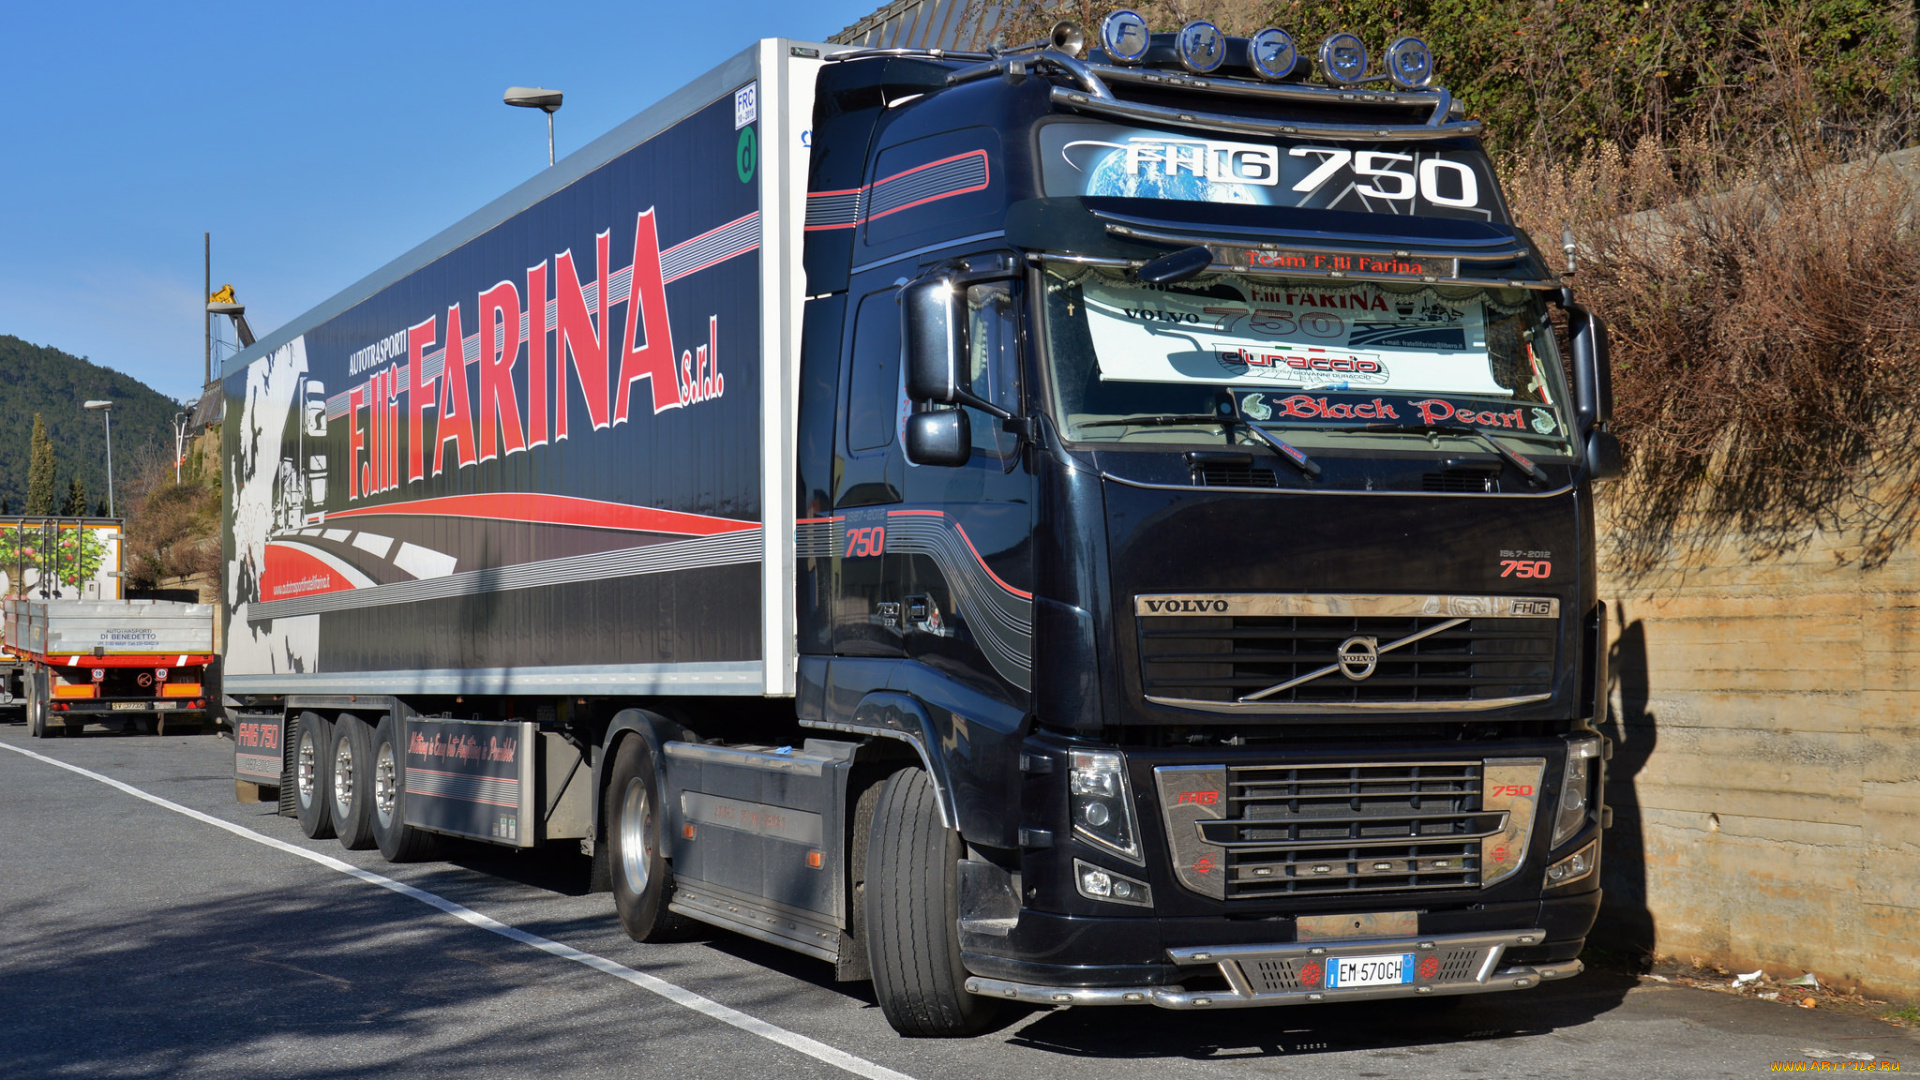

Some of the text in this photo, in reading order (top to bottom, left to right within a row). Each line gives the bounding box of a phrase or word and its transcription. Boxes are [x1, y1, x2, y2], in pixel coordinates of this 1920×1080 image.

[1115, 22, 1138, 45] F
[1190, 33, 1215, 57] H
[1262, 41, 1289, 62] 7
[738, 88, 754, 113] FRC
[741, 134, 752, 175] d
[1127, 137, 1479, 208] FH16 750
[1245, 251, 1423, 274] Team F.lli Farina
[1122, 306, 1345, 339] VOLVO 750
[349, 329, 407, 377] AUTOTRASPORTI
[349, 205, 724, 502] F.lli FARINA s.r.l.
[1221, 347, 1380, 372] duraccio
[1293, 370, 1331, 378] GIOVANNI
[1332, 373, 1373, 381] DURACCIO
[1273, 394, 1527, 430] Black Pearl
[845, 526, 885, 558] 750
[1500, 549, 1551, 558] 1967-2012
[1500, 560, 1552, 579] 750
[1144, 599, 1229, 613] VOLVO
[1512, 601, 1551, 615] FH16
[238, 722, 279, 750] FH16 750
[1178, 790, 1219, 806] FH16
[1492, 784, 1533, 798] 750
[1339, 963, 1358, 982] EM
[1361, 960, 1403, 982] 570GH
